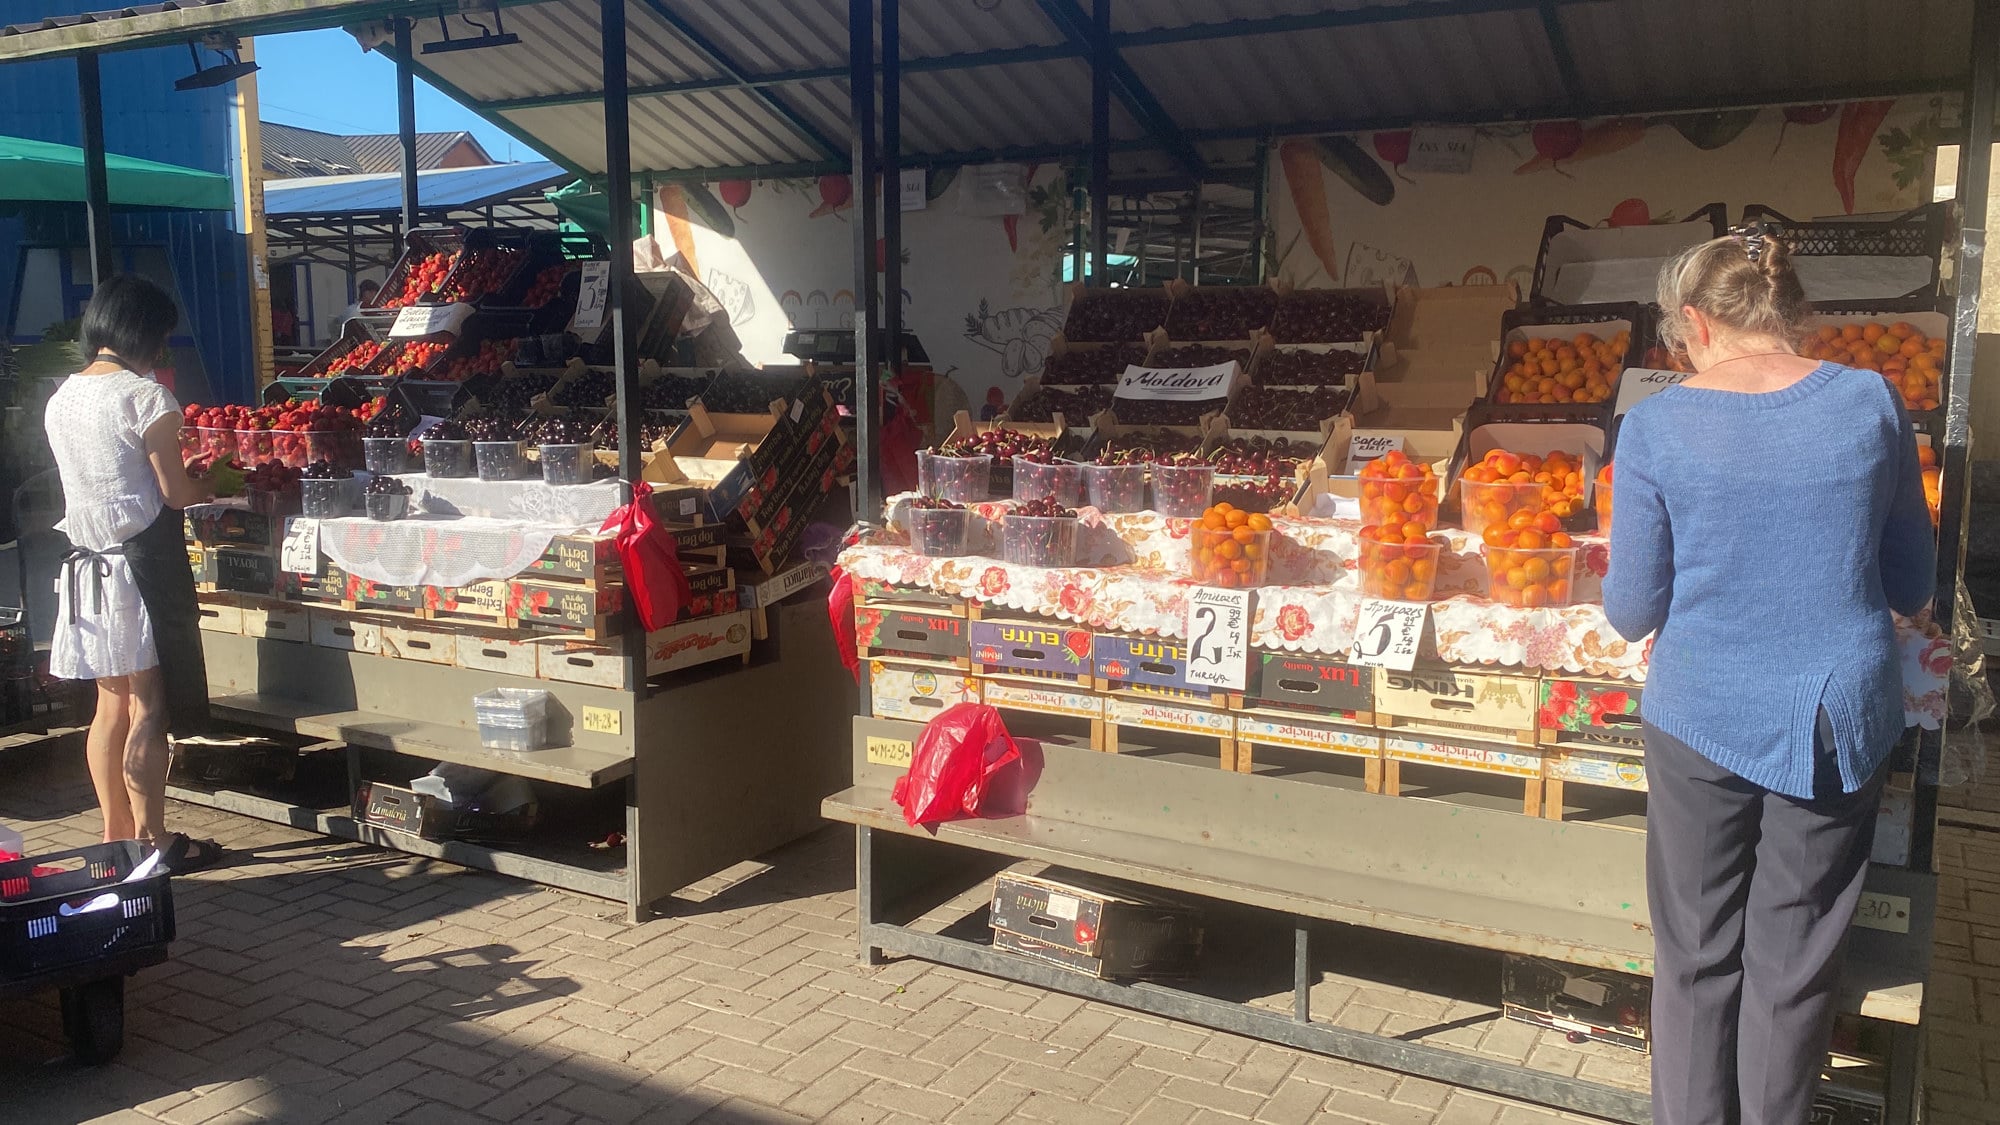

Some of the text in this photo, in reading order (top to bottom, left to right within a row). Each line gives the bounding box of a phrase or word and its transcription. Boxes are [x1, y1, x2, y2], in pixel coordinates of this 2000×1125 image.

[1125, 371, 1225, 388] Moldova
[698, 530, 715, 544] Top
[560, 543, 589, 562] Berry
[227, 556, 258, 569] ROYAL
[565, 559, 583, 572] Top
[707, 575, 723, 587] Top
[325, 585, 339, 596] Top
[395, 588, 411, 600] Top
[476, 597, 503, 612] Extra
[560, 597, 589, 616] Berry
[566, 612, 583, 624] Top
[900, 614, 924, 624] Quality
[1229, 608, 1241, 619] 99
[1227, 618, 1240, 629] €
[1002, 628, 1059, 646] ELITA
[1190, 606, 1223, 665] 2
[1353, 612, 1395, 660] 5
[1099, 664, 1130, 676] IRMINI
[1282, 660, 1314, 672] Quality
[1386, 676, 1474, 698] KING
[1142, 706, 1194, 725] Principe
[1279, 724, 1336, 744] Principe
[1430, 741, 1494, 763] Principe
